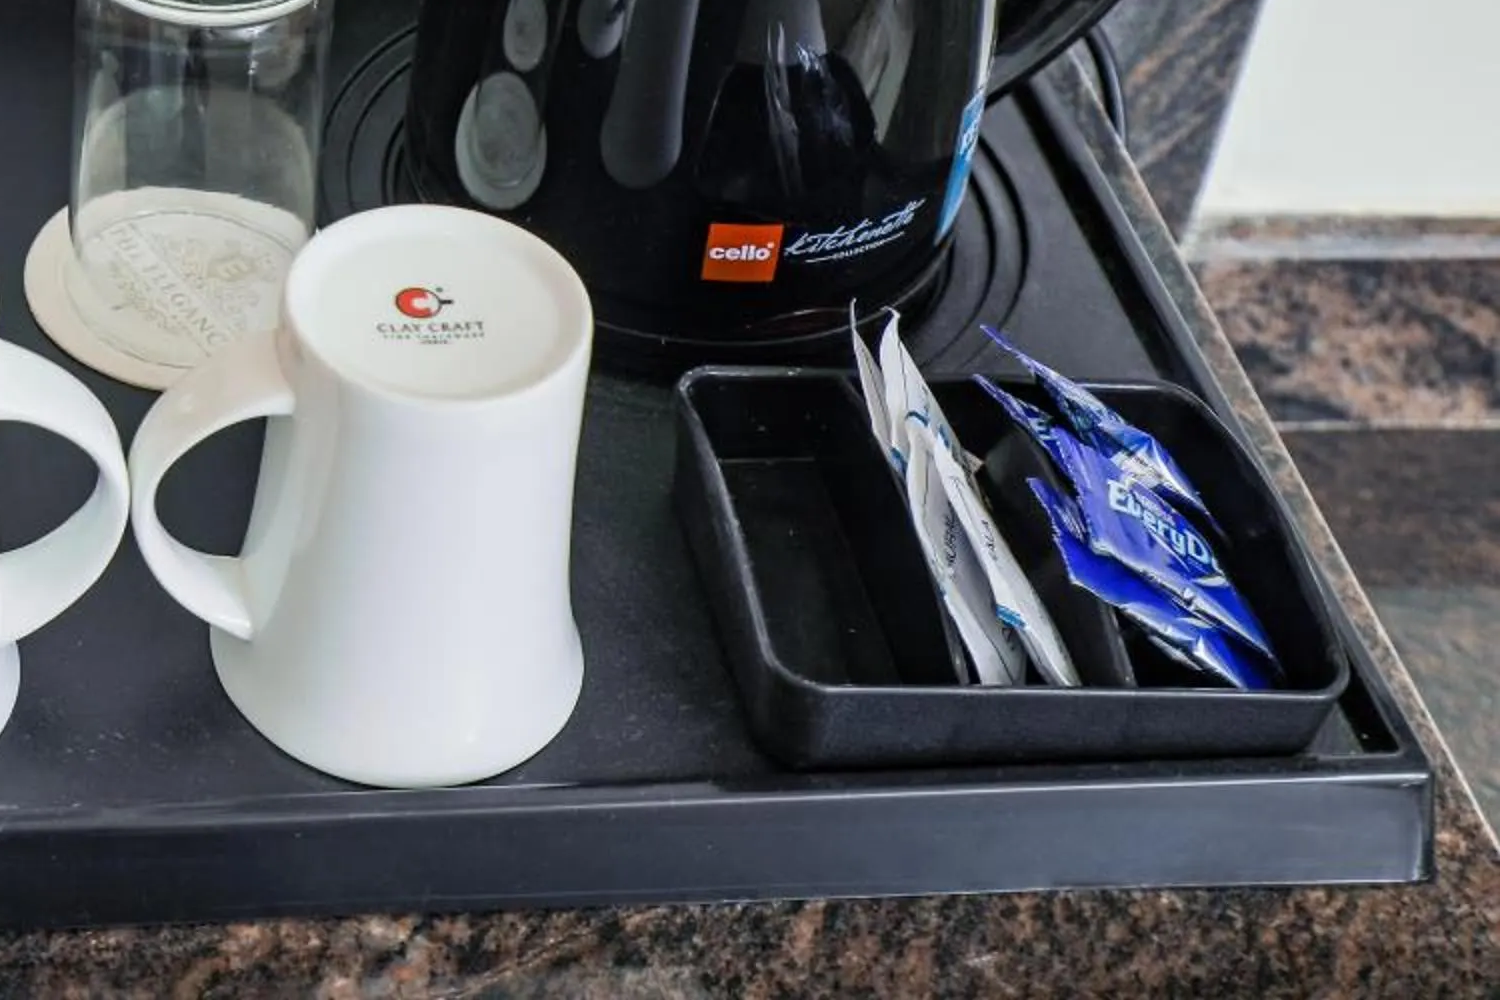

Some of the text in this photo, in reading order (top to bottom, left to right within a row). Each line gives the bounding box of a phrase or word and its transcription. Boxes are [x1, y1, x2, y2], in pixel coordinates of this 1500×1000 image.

[709, 243, 771, 261] cello
[376, 320, 484, 333] CLAY CRAFT
[1106, 478, 1213, 566] EveryD
